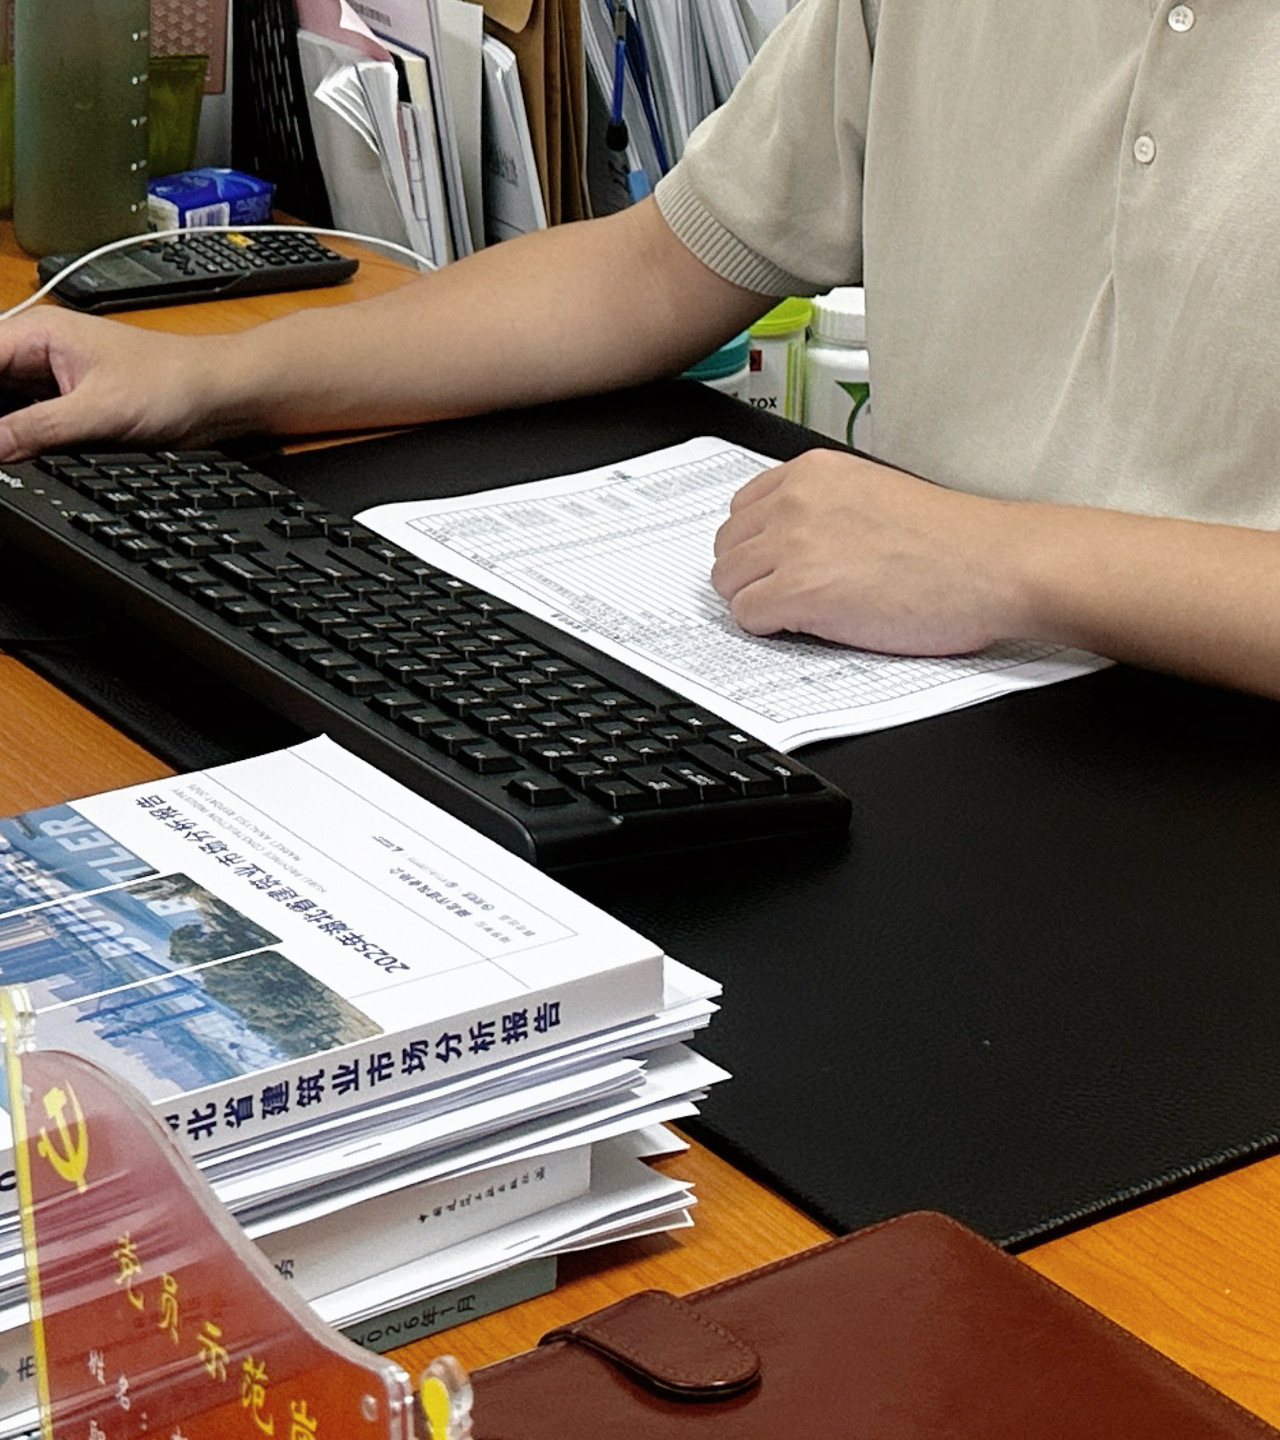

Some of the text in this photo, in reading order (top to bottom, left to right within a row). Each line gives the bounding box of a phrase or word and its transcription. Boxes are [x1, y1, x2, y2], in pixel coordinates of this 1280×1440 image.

[135, 794, 410, 974] 2025年湖北省建筑业市场分析报告
